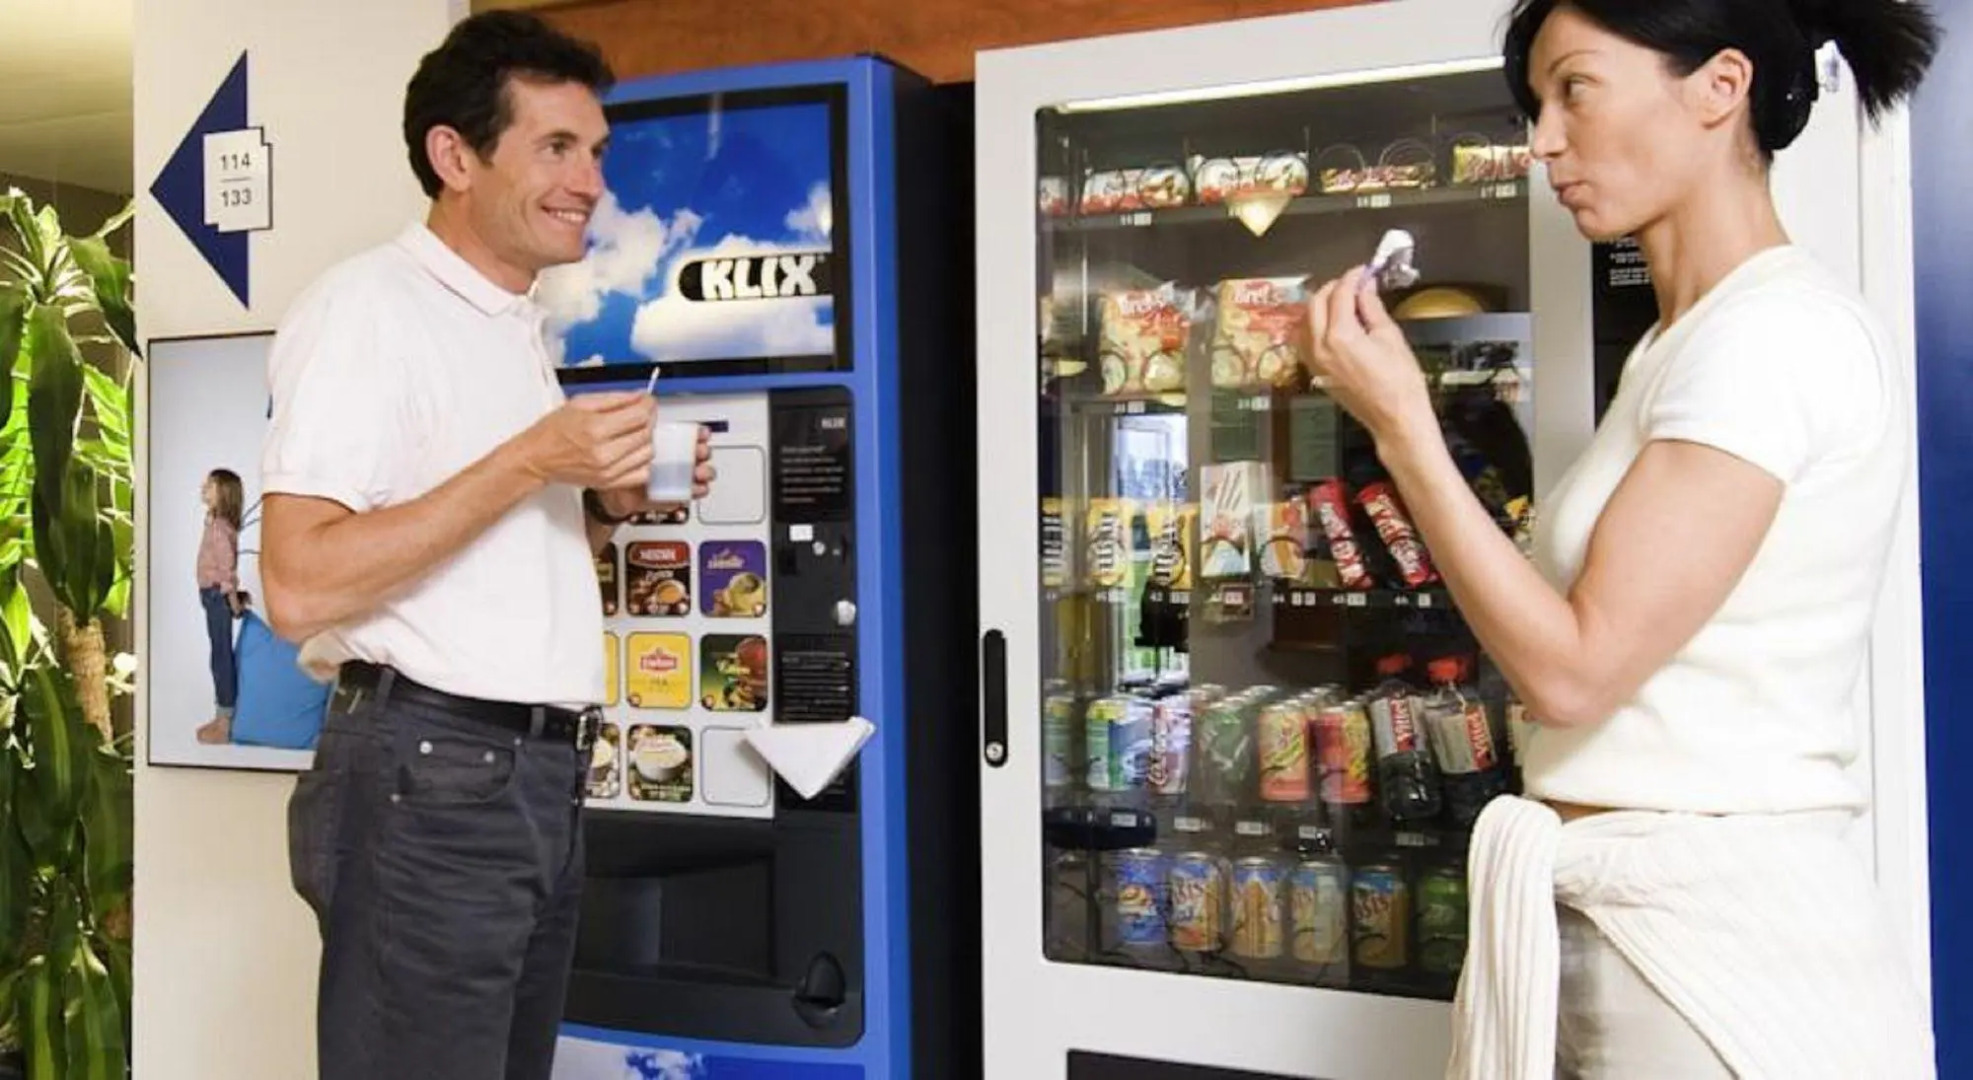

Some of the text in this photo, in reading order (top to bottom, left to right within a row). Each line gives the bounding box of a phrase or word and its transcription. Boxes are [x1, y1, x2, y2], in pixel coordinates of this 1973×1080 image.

[220, 152, 251, 170] 114
[220, 187, 252, 208] 133
[701, 254, 817, 299] KLIX
